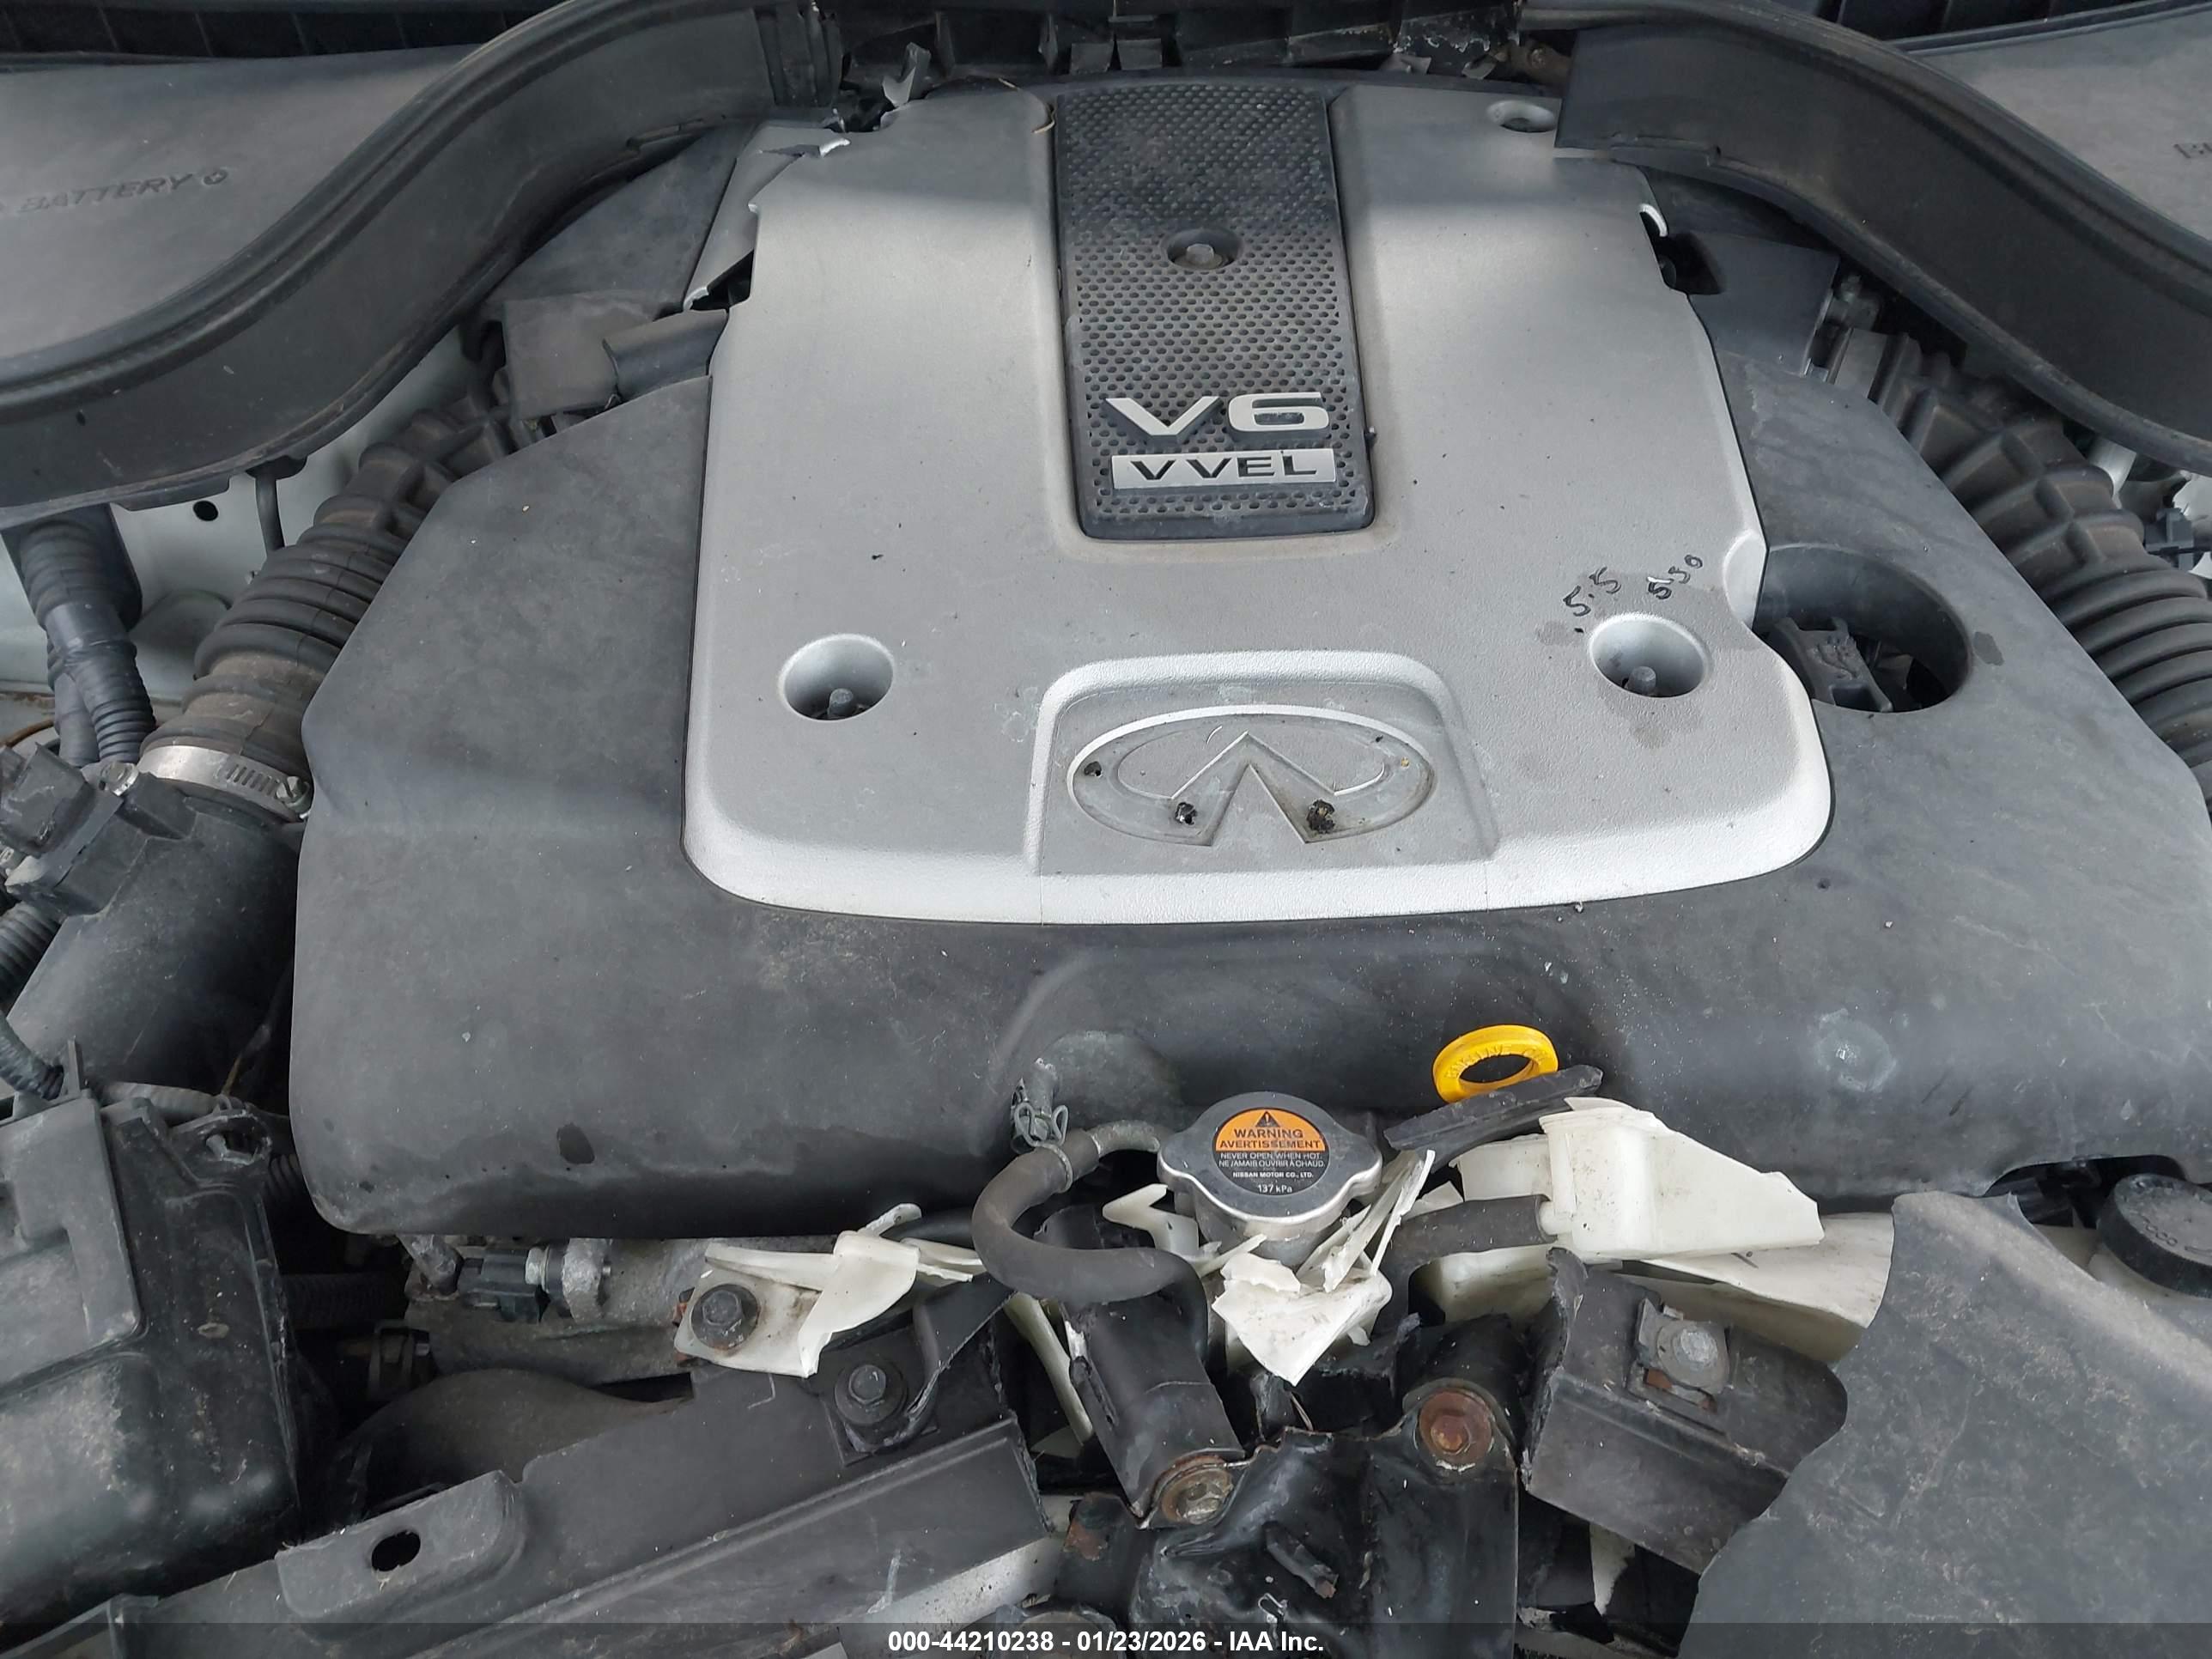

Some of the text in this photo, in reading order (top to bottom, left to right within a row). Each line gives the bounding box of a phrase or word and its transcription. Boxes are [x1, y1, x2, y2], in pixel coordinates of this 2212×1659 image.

[17, 173, 193, 213] BATTERY
[1104, 391, 1330, 437] V6
[1130, 455, 1318, 481] VVEL
[1233, 1128, 1304, 1139] WARNING
[1219, 1139, 1321, 1149] AVERTISSEMENT
[1257, 1184, 1292, 1194] 137 kPa
